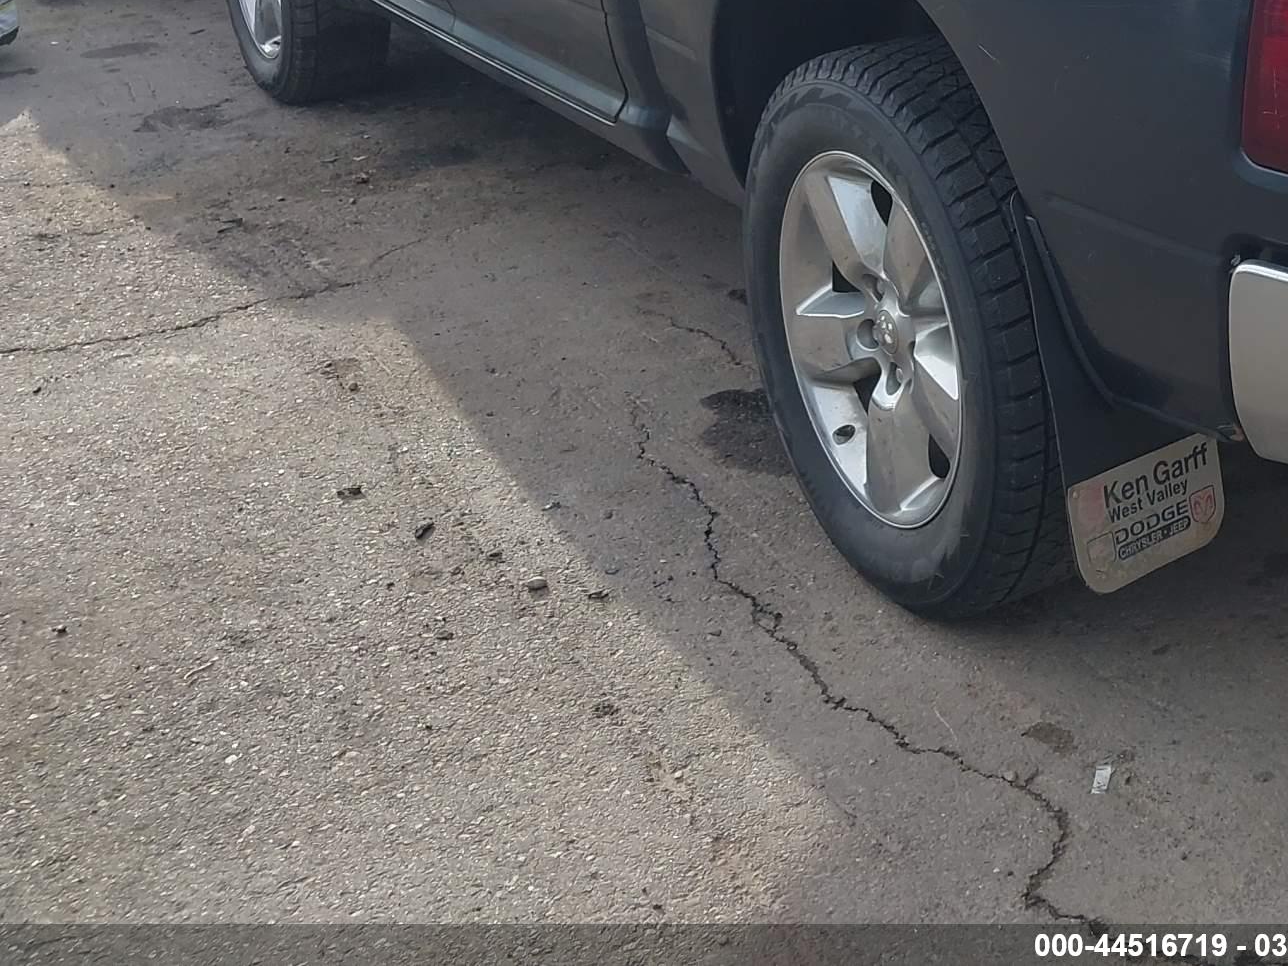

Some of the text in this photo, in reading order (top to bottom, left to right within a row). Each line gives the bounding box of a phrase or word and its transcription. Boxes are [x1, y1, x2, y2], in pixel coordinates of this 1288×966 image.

[1104, 442, 1208, 508] Ken Garff
[1108, 479, 1188, 523] West Valley
[1115, 499, 1188, 545] DODGE
[1120, 520, 1188, 559] CHRYSLER JEEP
